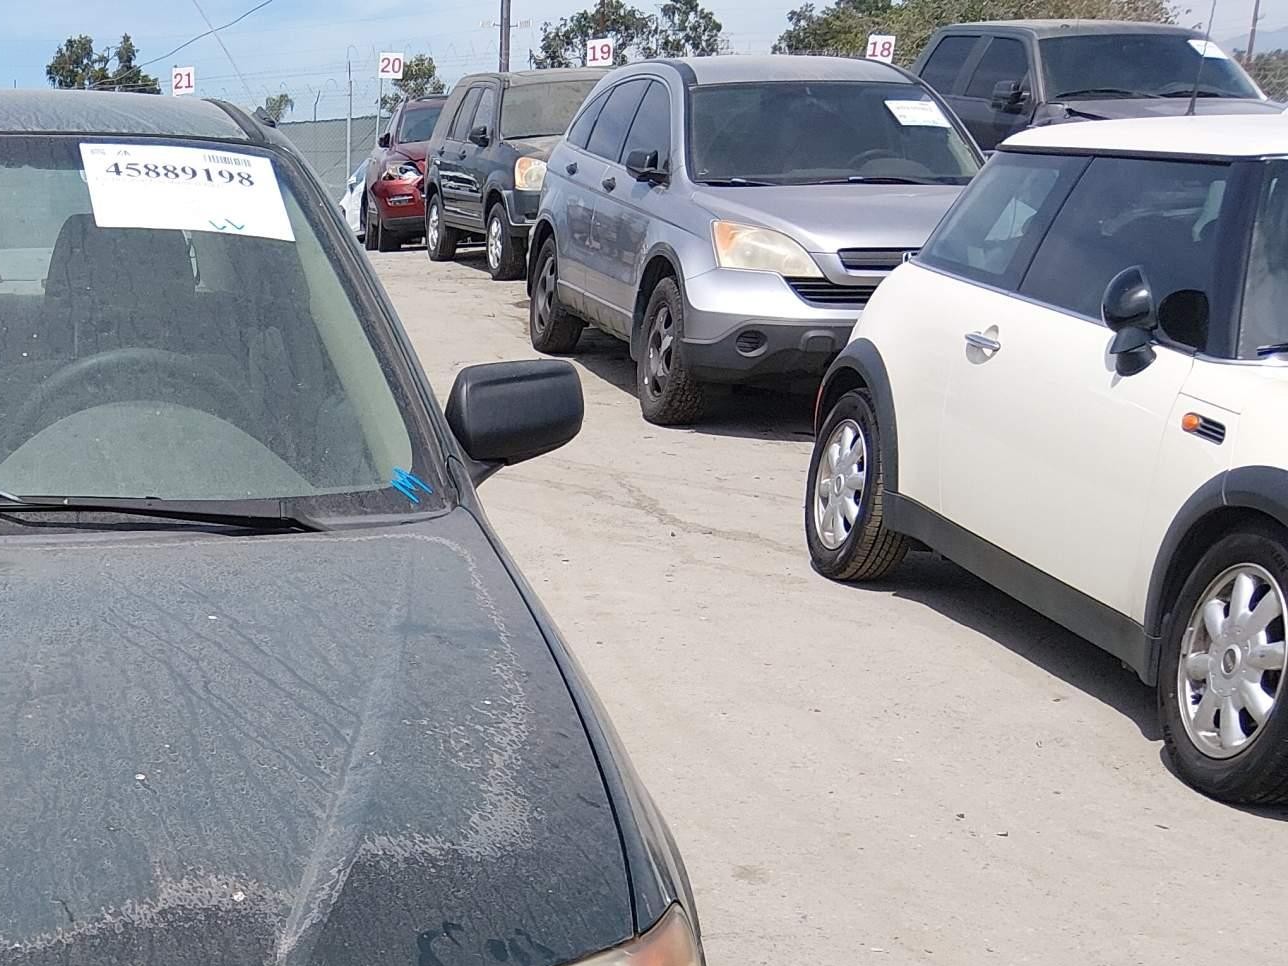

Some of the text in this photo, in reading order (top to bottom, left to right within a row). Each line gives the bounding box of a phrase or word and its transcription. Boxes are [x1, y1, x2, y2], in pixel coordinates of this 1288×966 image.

[588, 44, 611, 61] 19
[868, 41, 892, 58] 18
[380, 57, 402, 74] 20
[173, 71, 193, 89] 21
[105, 162, 256, 188] 45889198
